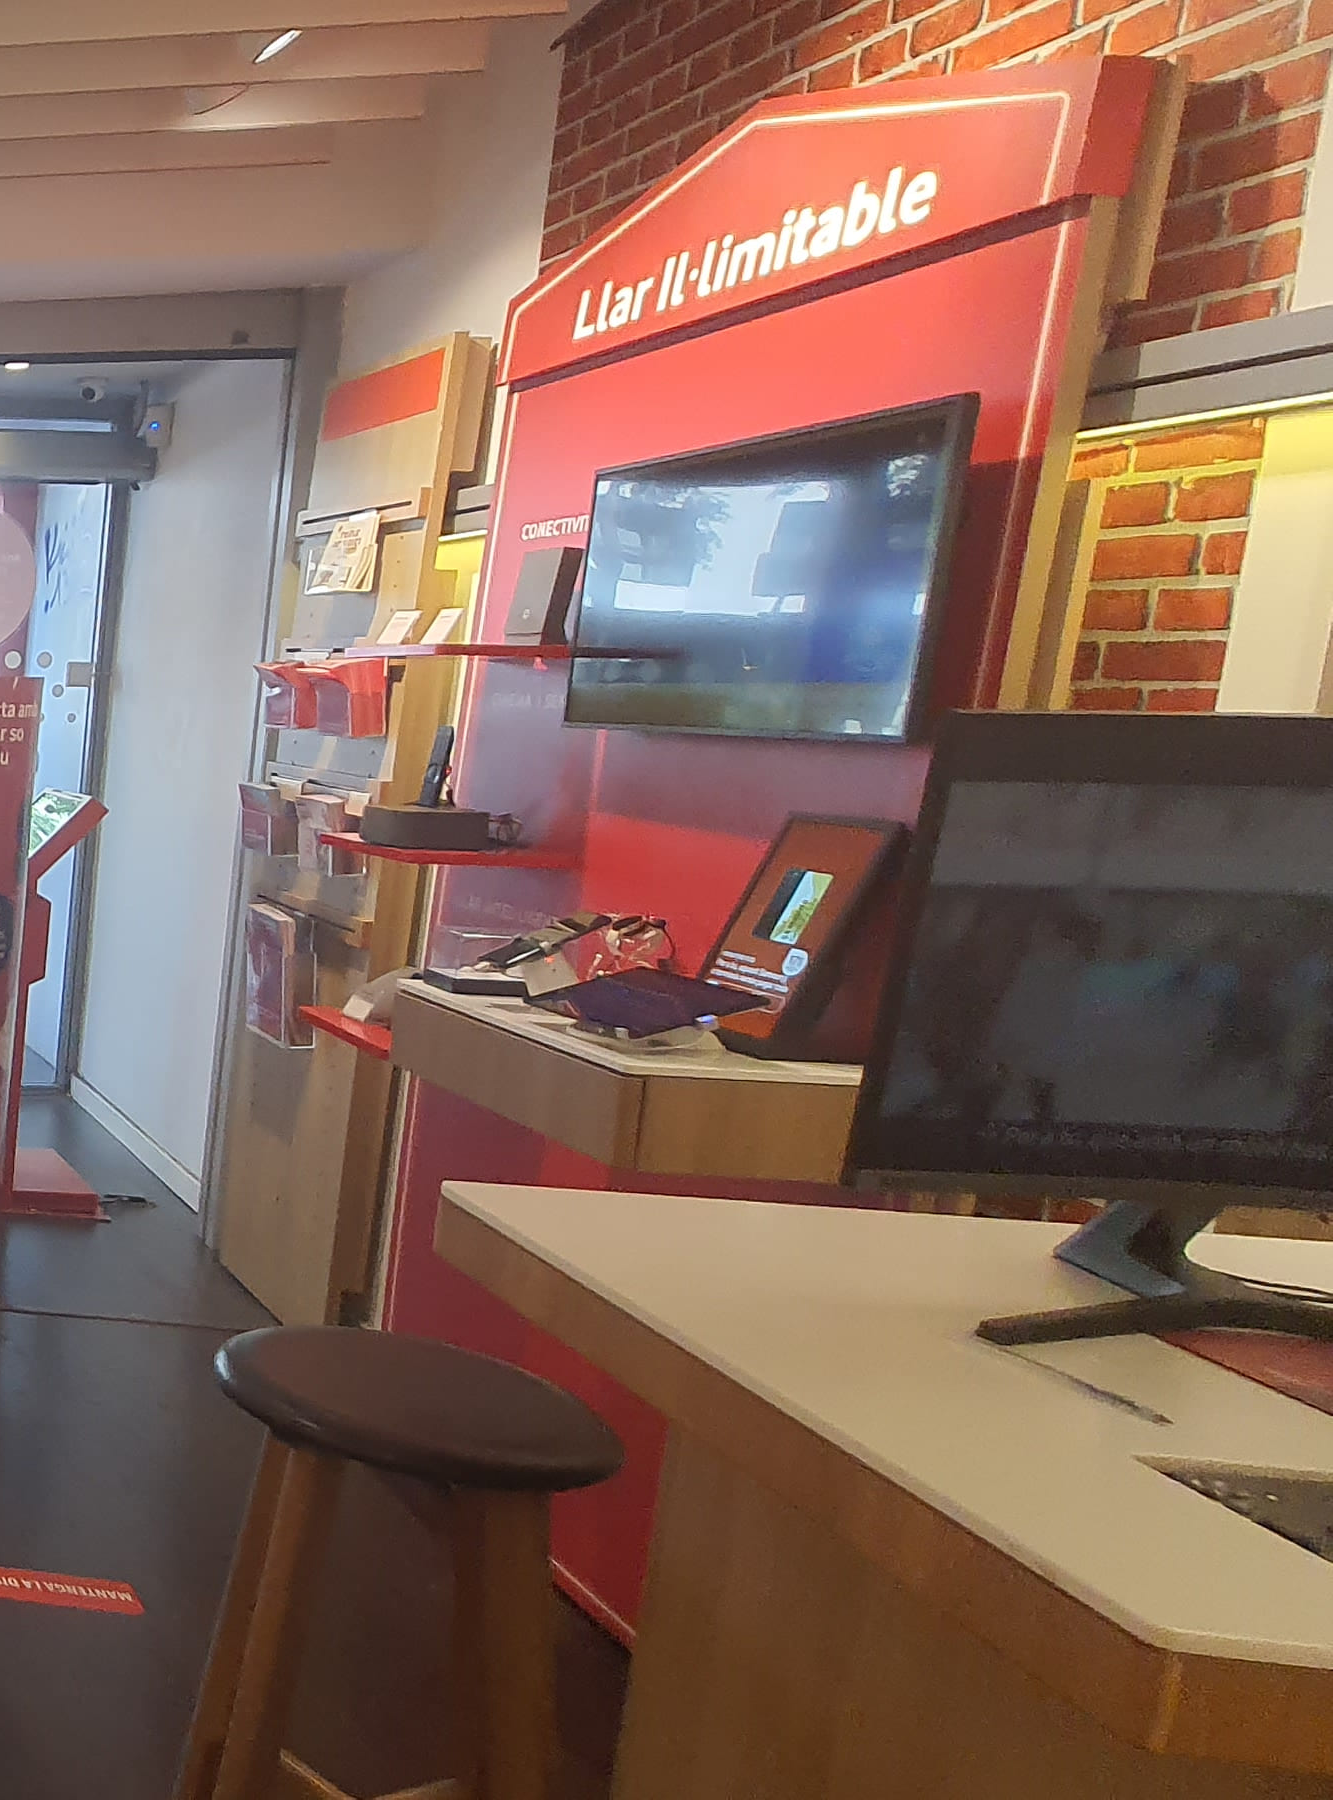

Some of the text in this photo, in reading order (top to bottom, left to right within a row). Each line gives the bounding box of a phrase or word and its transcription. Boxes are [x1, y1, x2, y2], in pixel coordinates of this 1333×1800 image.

[572, 166, 937, 341] Llar Il·limitable
[9, 727, 24, 741] so
[21, 1579, 41, 1591] LA
[43, 1581, 133, 1601] MANTENGA
